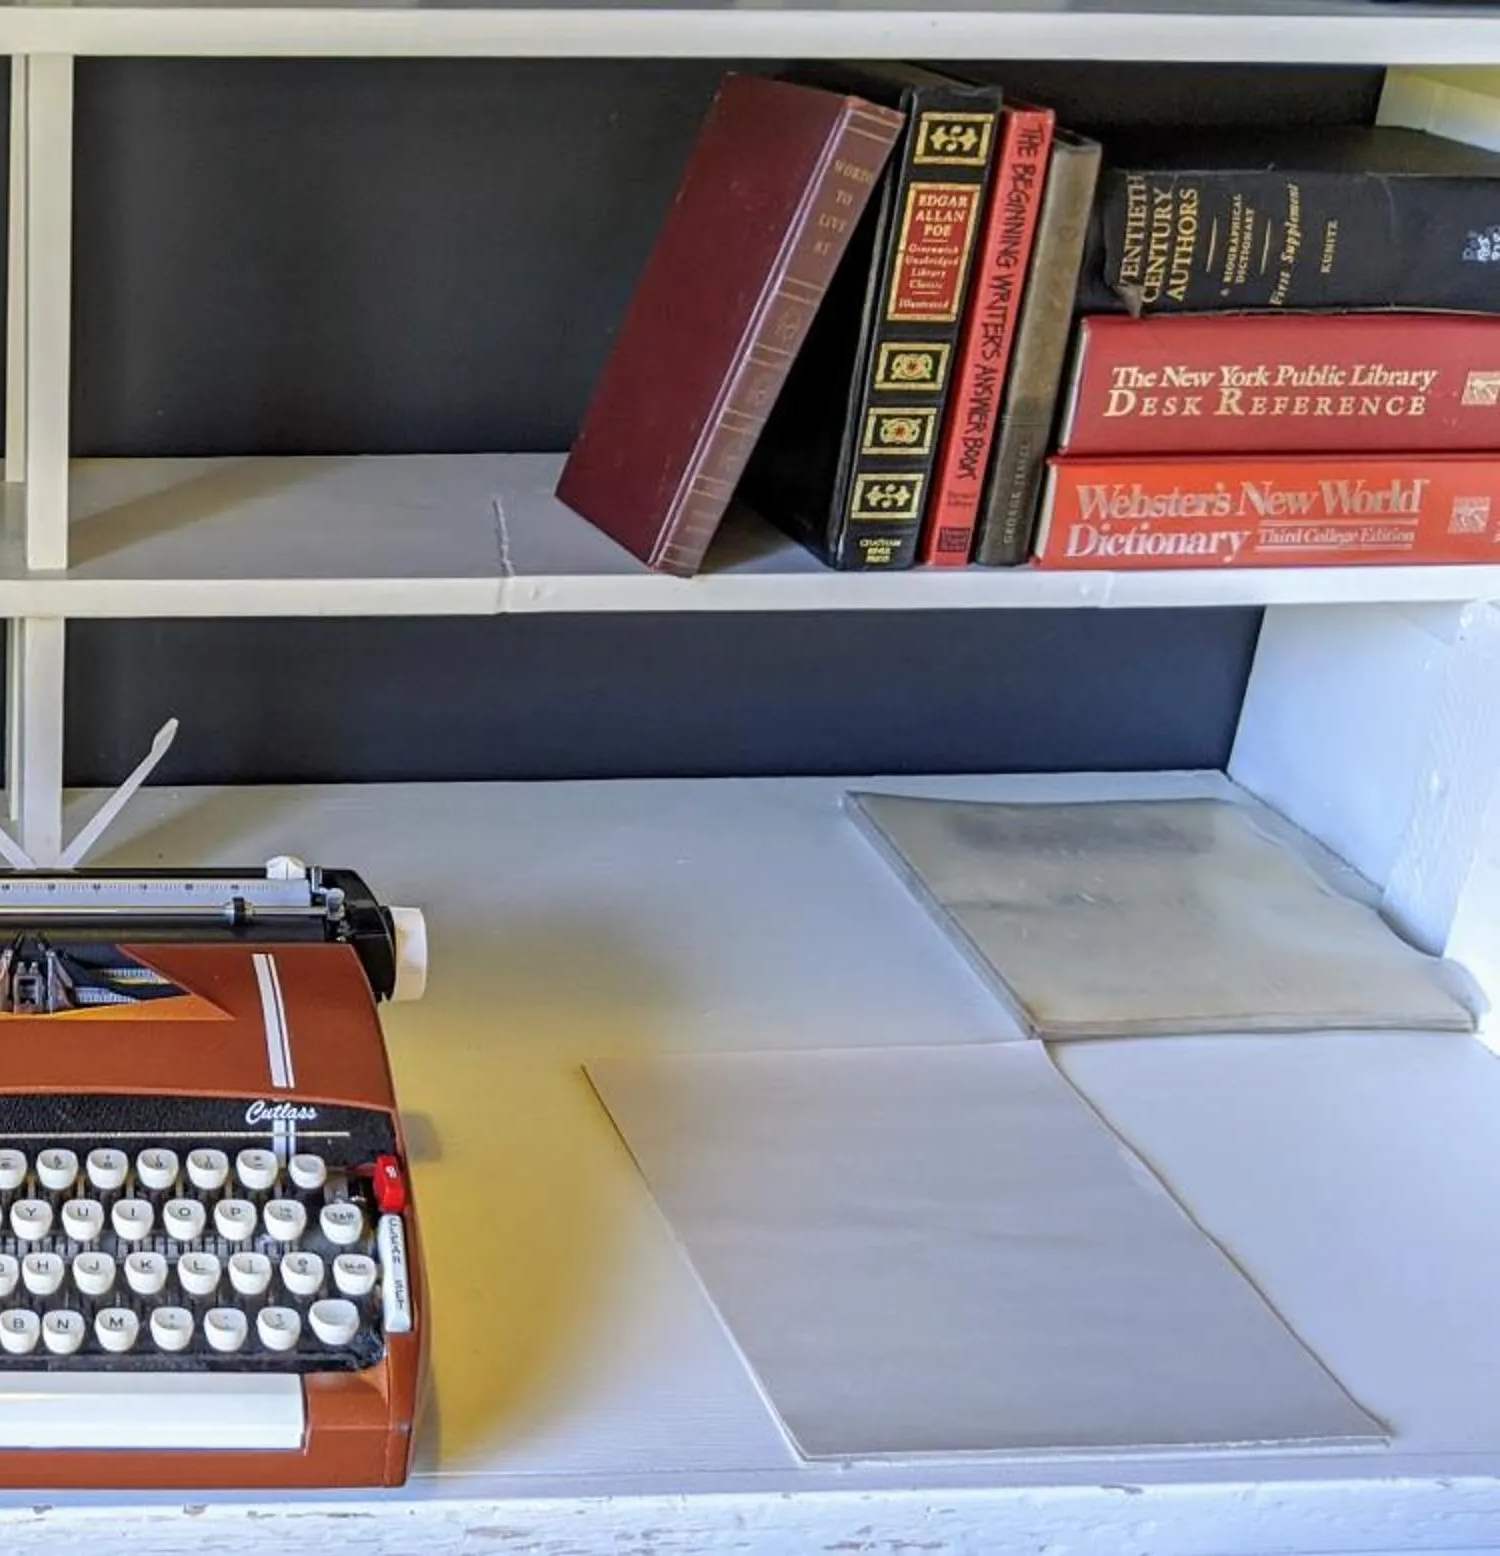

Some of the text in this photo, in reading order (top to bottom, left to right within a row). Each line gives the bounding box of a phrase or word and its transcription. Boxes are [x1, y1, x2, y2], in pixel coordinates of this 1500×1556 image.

[1018, 122, 1045, 157] THE
[918, 194, 968, 208] EDGAR
[915, 209, 967, 222] ALLAN
[996, 163, 1037, 268] BEGINNING
[923, 223, 953, 237] POE
[1280, 182, 1301, 264] Supplement
[1141, 186, 1174, 303] CENTURY
[1166, 187, 1198, 301] AUTHORS
[1223, 193, 1242, 284] BIOGRAPHICAL
[1235, 207, 1255, 284] DICTIONARY
[1320, 218, 1339, 273] KUNITZ
[911, 267, 947, 279] Library
[1112, 363, 1439, 393] The New York Public Library
[964, 362, 1000, 436] ANSWER
[1103, 387, 1427, 417] DESK REFERENCE
[1075, 478, 1423, 521] Webster's New World
[1065, 521, 1252, 563] Dictionary
[1258, 526, 1302, 546] Third
[1359, 525, 1415, 544] Edition
[245, 1100, 318, 1125] Cutlass
[26, 1207, 37, 1217] Y
[77, 1207, 89, 1217] U
[178, 1207, 192, 1217] O
[231, 1207, 242, 1217] P
[37, 1260, 49, 1271] H
[89, 1260, 99, 1271] J
[141, 1259, 153, 1270] K
[193, 1259, 206, 1270] L
[13, 1318, 25, 1329] B
[57, 1318, 69, 1330] N
[110, 1317, 124, 1328] M
